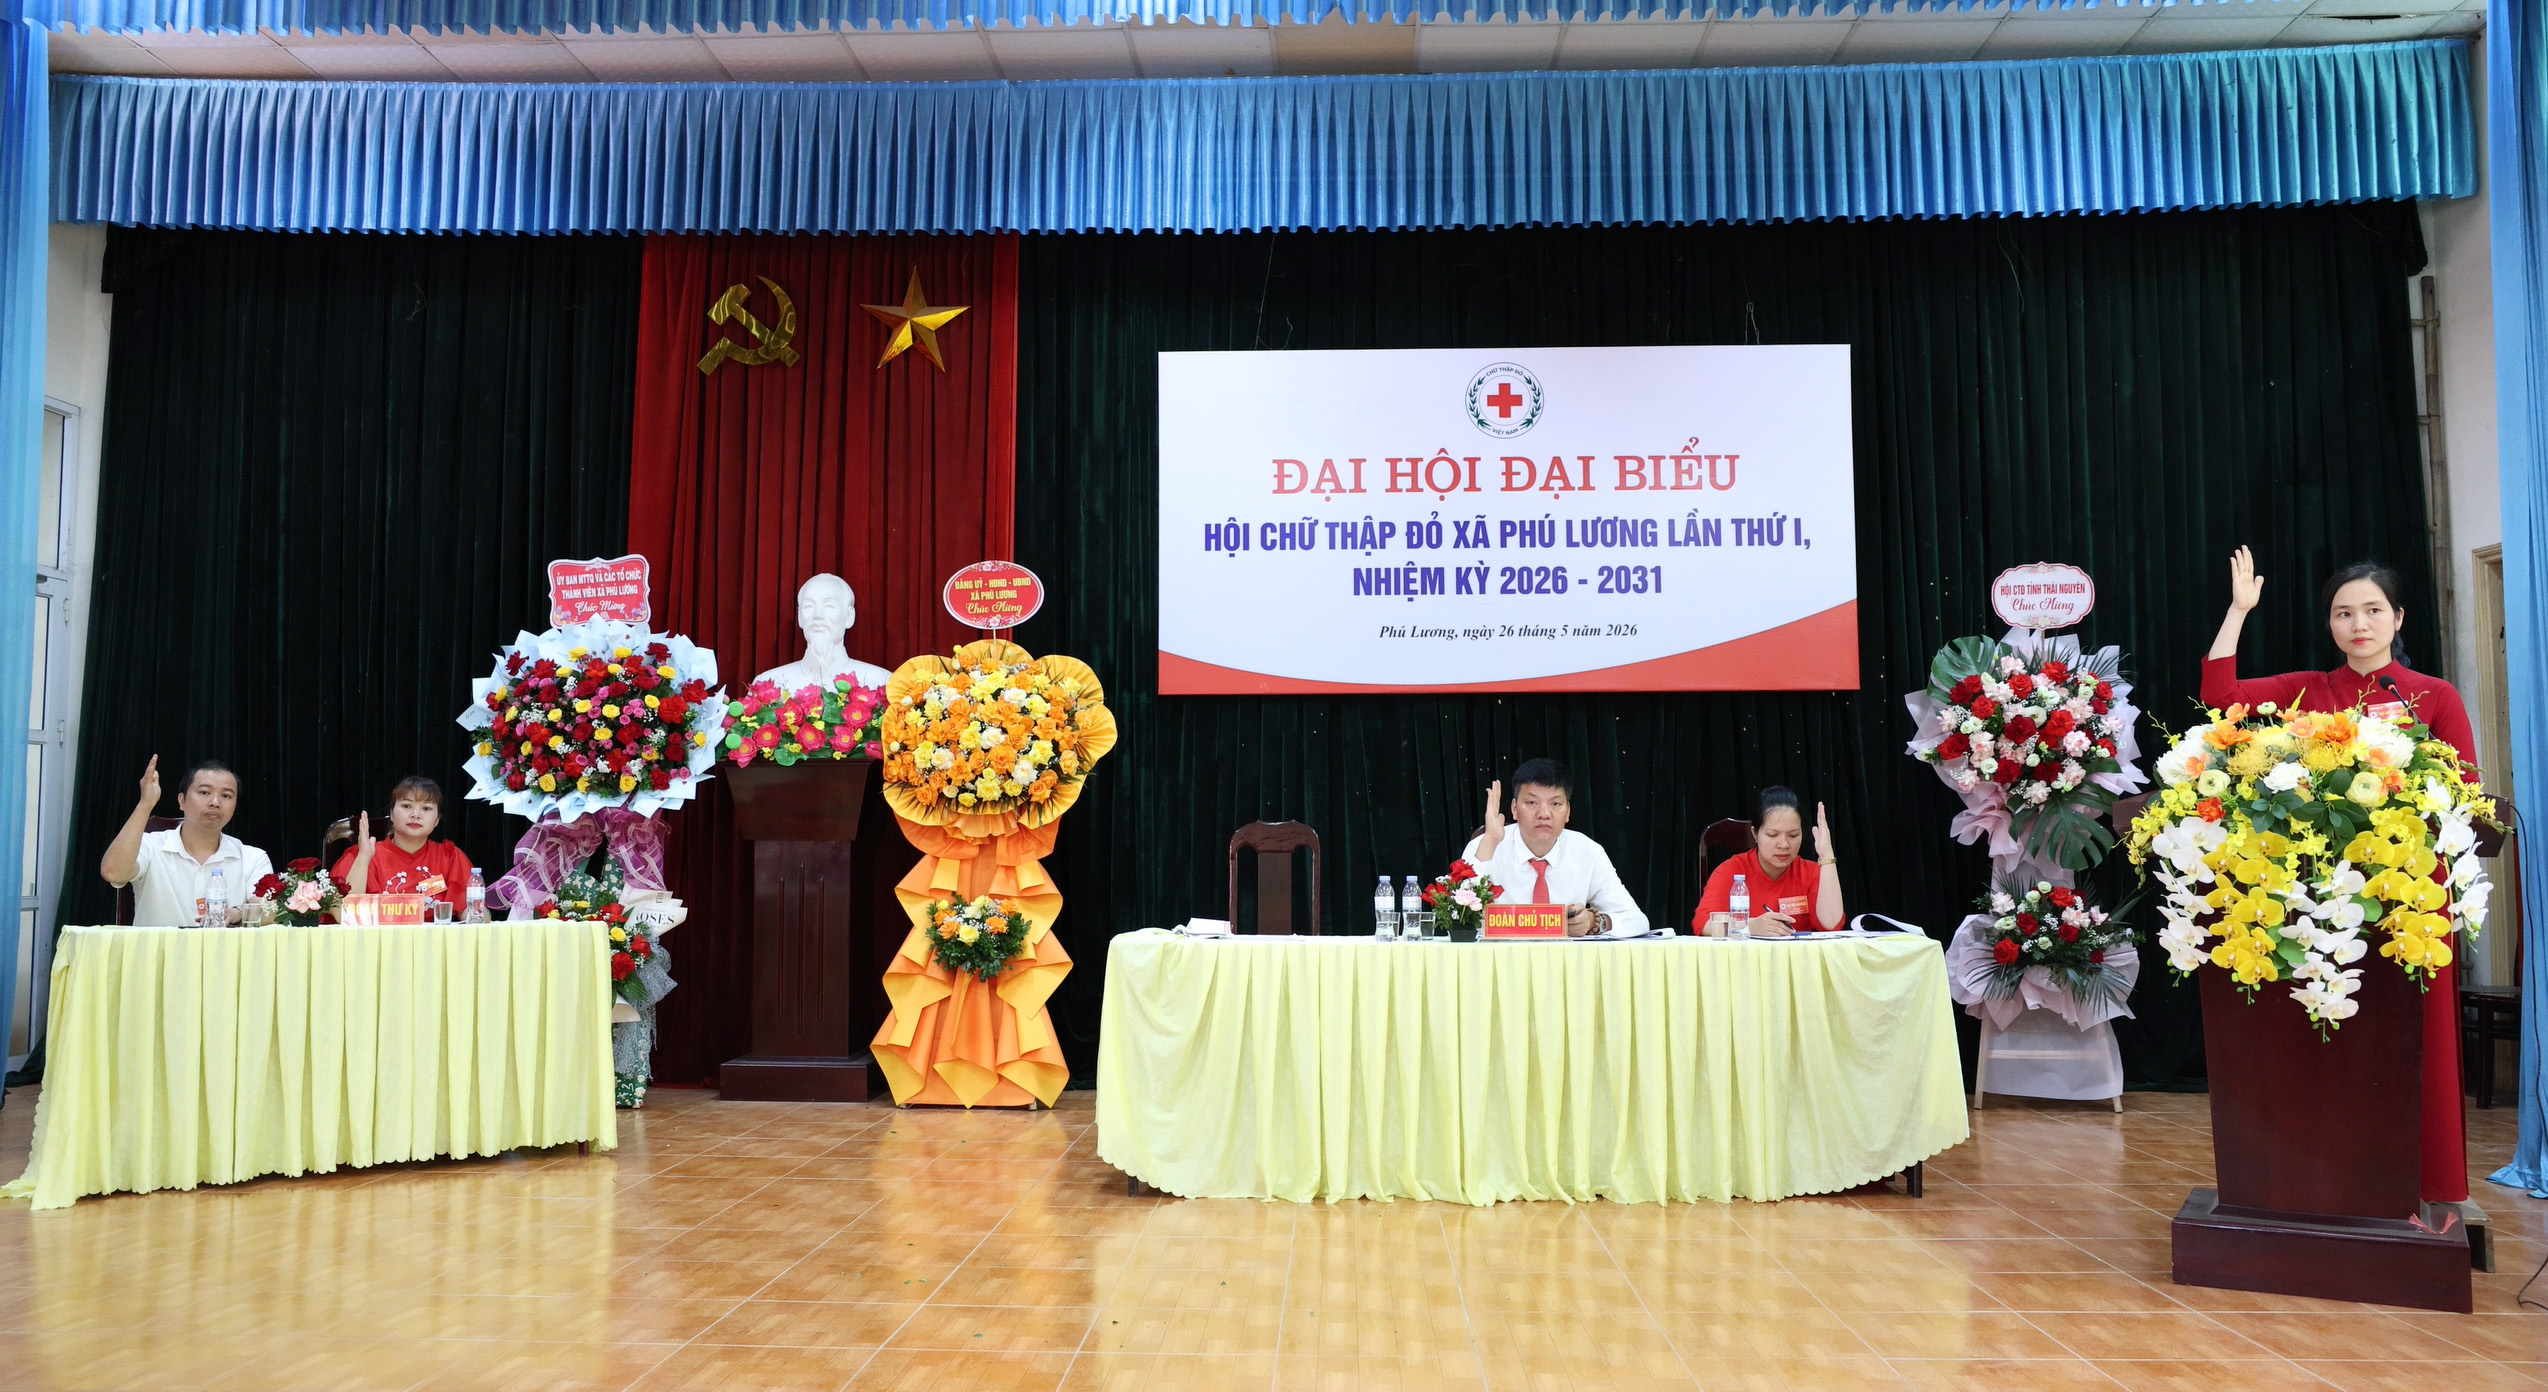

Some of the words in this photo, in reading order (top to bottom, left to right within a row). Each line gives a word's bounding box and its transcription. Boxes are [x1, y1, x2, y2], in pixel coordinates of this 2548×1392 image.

[1486, 368, 1499, 377] CHỮ
[1492, 427, 1505, 436] VIỆT
[1273, 459, 1366, 501] ĐẠI
[1386, 448, 1480, 501] HỘI
[1501, 457, 1596, 500] ĐẠI
[1615, 438, 1739, 491] BIỂU
[1204, 516, 1249, 558] HỘI
[1261, 516, 1319, 551] CHỮ
[1325, 516, 1396, 557] THẬP
[1406, 511, 1443, 550] ĐỎ
[1453, 514, 1491, 549] XÃ
[1500, 512, 1556, 549] PHÚ
[1565, 517, 1658, 548] LƯƠNG
[1668, 508, 1721, 547] LẦN
[1731, 511, 1787, 547] THỨ
[1794, 517, 1811, 550] I,
[566, 574, 578, 585] BAN
[578, 573, 595, 584] MTTQ
[1013, 577, 1031, 586] UBND
[1353, 561, 1444, 602] NHIỆM
[1456, 559, 1490, 595] KỲ
[1499, 565, 1568, 595] 2026
[1598, 565, 1662, 595] 2031
[562, 586, 581, 599] THÀNH
[582, 585, 596, 598] VIÊN
[606, 583, 618, 596] PHÚ
[619, 583, 638, 595] LƯƠNG
[995, 589, 1018, 600] LƯƠNG
[2000, 583, 2011, 598] HỘI
[2043, 581, 2058, 594] THÁI
[2059, 580, 2086, 594] NGUYÊN
[574, 601, 599, 613] Chúc
[965, 602, 990, 614] Chúc
[2010, 598, 2036, 611] Chúc
[1379, 625, 1406, 638] Phú
[1411, 625, 1458, 640] Lương,
[1463, 625, 1495, 640] ngày
[1499, 625, 1514, 637] 26
[1518, 625, 1556, 640] tháng
[1561, 625, 1568, 637] 5
[1573, 625, 1601, 637] năm
[1606, 624, 1638, 637] 2026
[381, 902, 403, 916] THƯ
[404, 901, 419, 916] KÝ
[1489, 911, 1516, 927] ĐOÀN
[1518, 910, 1537, 927] CHỦ
[1539, 914, 1561, 929] TỊCH
